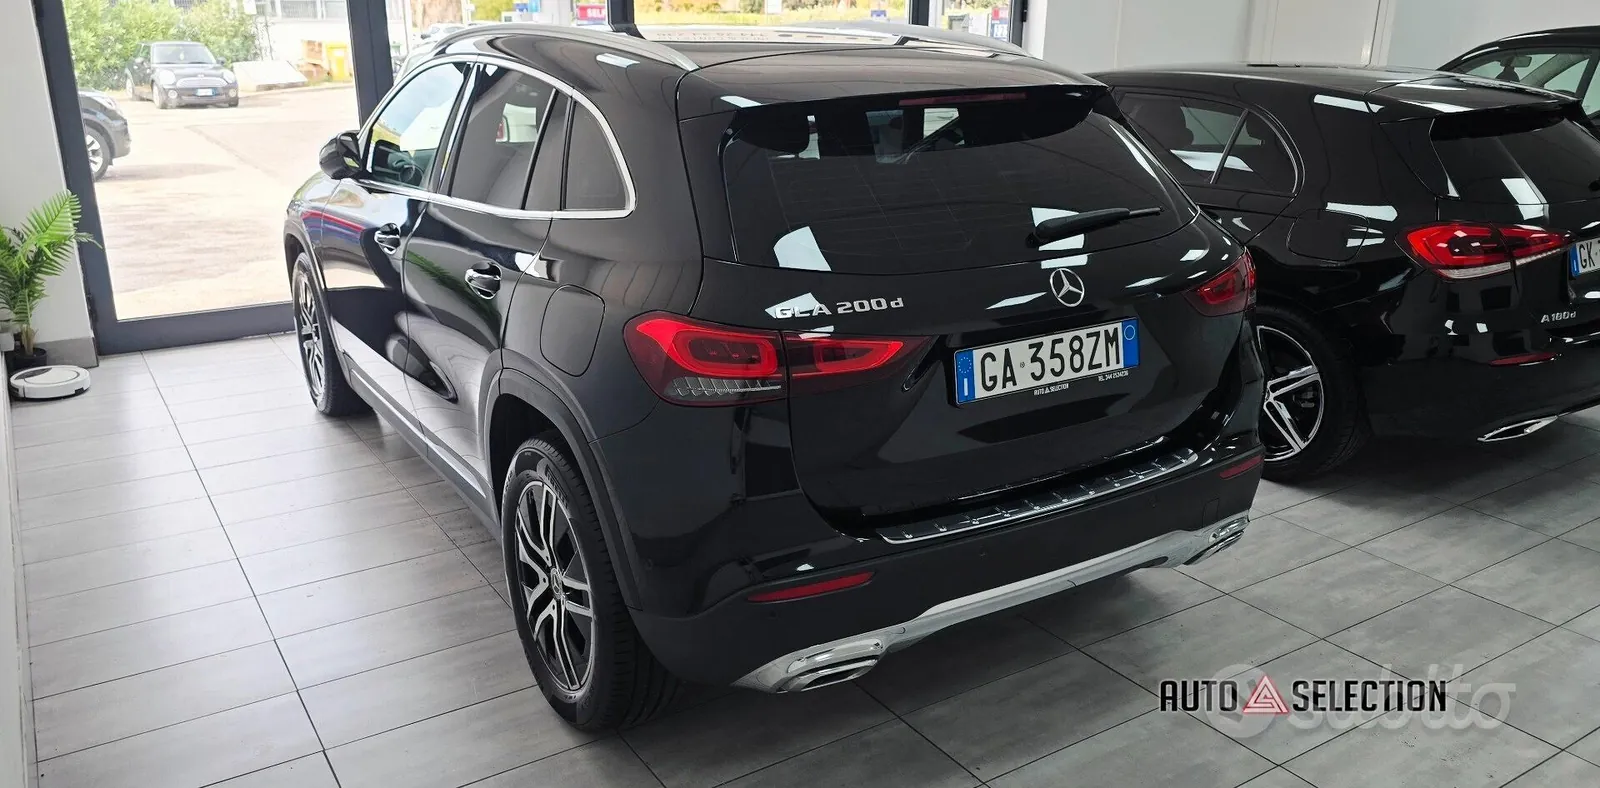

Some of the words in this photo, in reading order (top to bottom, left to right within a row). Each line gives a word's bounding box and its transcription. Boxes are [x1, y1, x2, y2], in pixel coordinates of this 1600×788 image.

[1578, 241, 1595, 269] GK
[775, 303, 832, 319] GLA
[980, 347, 1018, 392] GA
[1028, 326, 1121, 382] 358ZM
